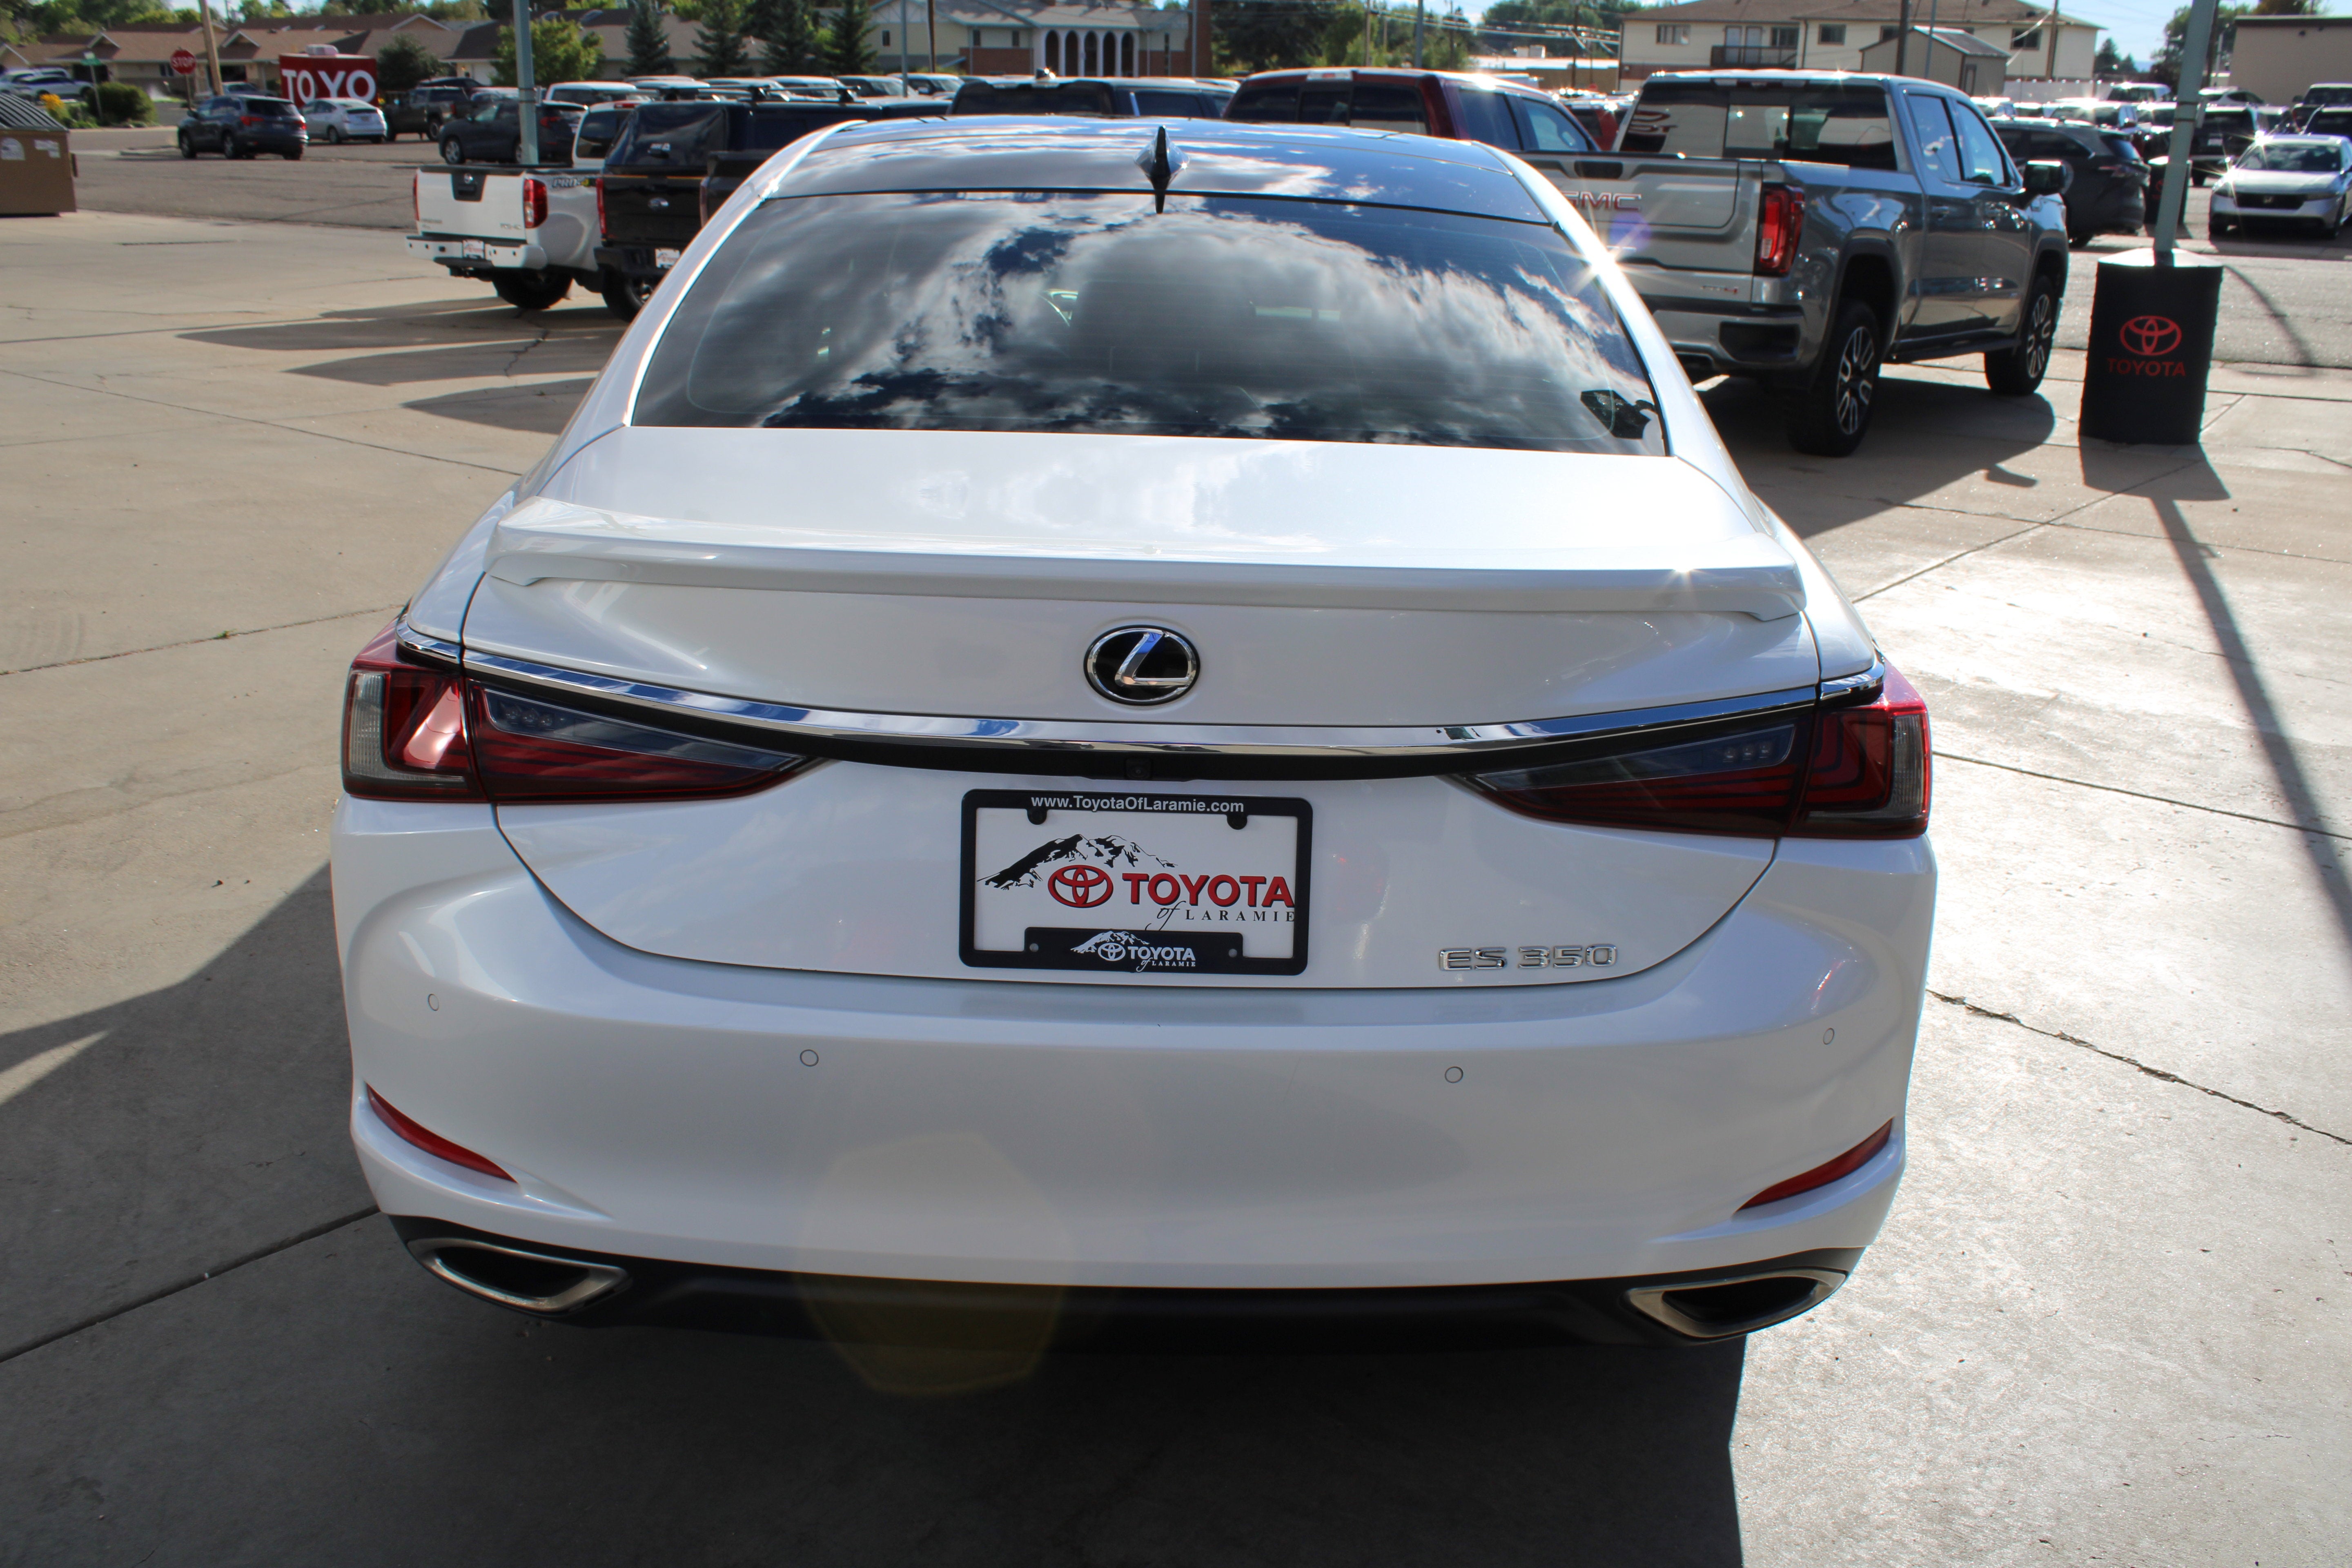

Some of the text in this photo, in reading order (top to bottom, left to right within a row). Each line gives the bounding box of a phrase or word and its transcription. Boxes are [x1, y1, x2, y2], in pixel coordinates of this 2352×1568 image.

[171, 57, 194, 67] STOP
[281, 69, 376, 105] TOYO
[2107, 358, 2186, 377] TOYOTA
[1031, 795, 1244, 812] www.ToyotaOfLaramie.com
[1122, 873, 1294, 907] TOYOTA
[1145, 900, 1294, 930] of LARAMIE
[1127, 946, 1196, 961] TOYOTA
[1439, 944, 1617, 971] ES 350
[1136, 957, 1153, 972] of
